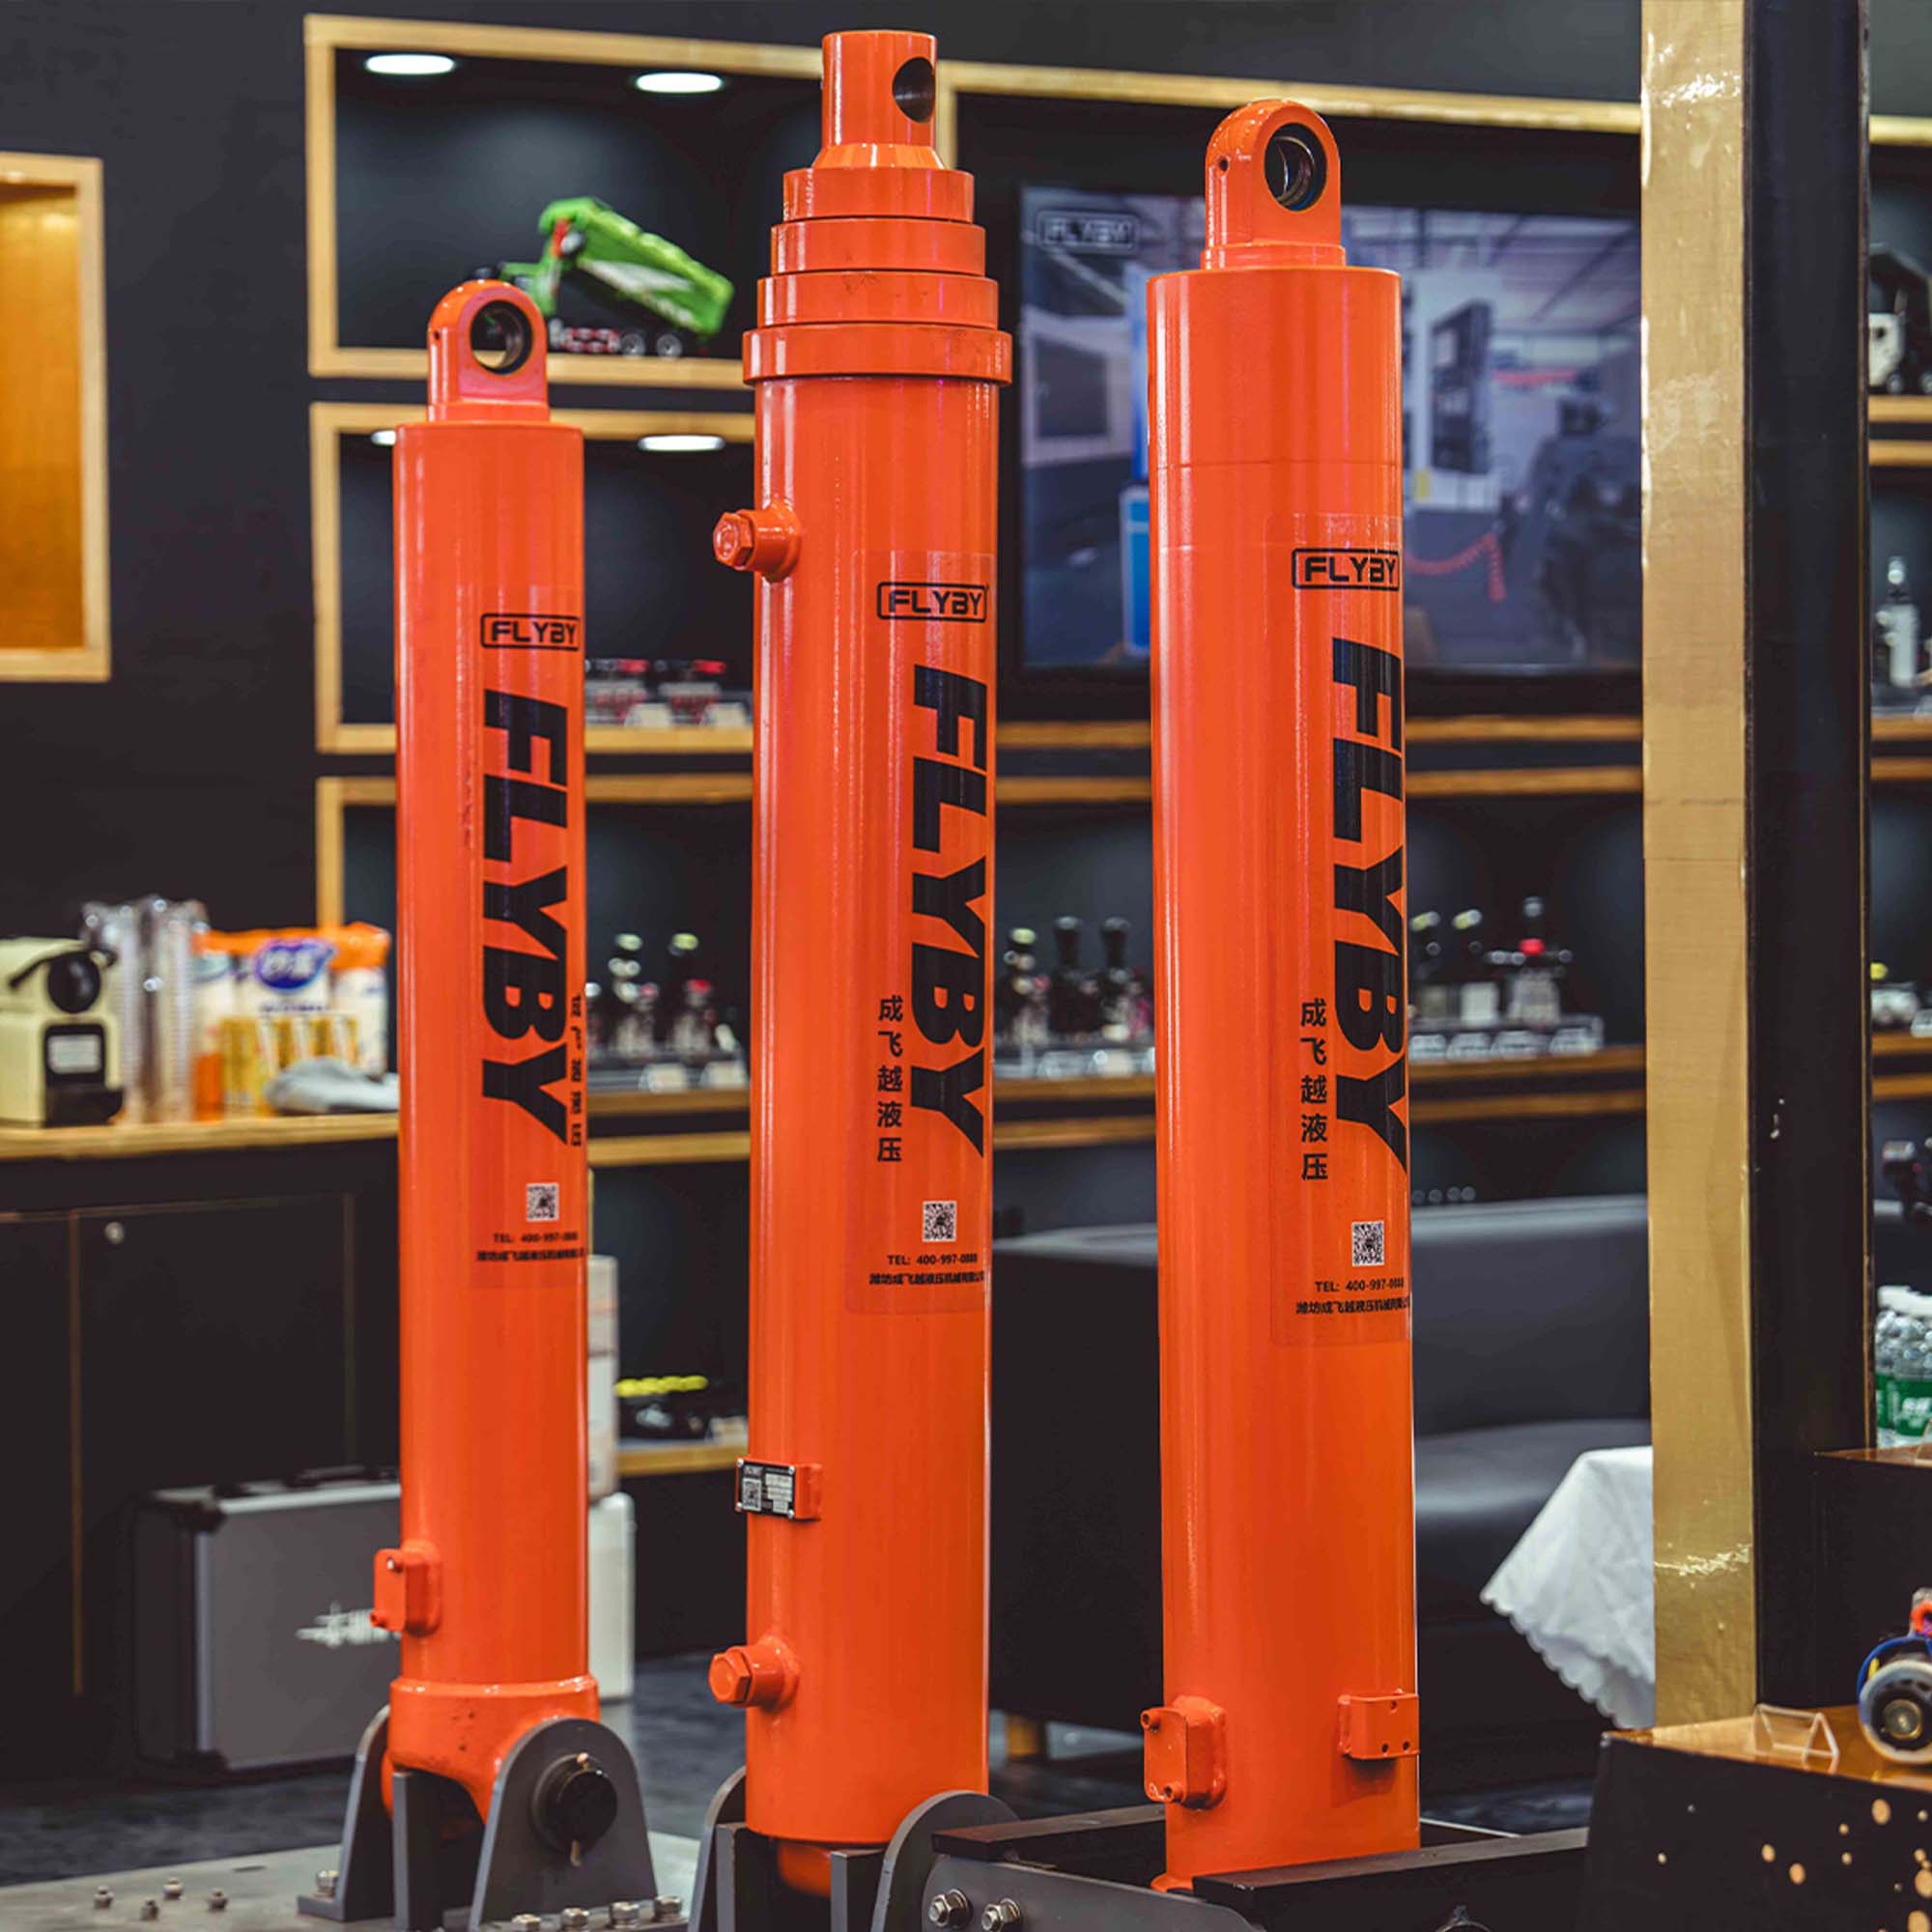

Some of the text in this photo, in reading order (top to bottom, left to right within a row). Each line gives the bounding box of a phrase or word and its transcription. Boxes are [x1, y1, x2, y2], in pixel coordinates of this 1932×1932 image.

[491, 621, 577, 644] FLYBY
[889, 589, 982, 616] FLYBY
[1305, 556, 1396, 582] FLYBY
[482, 689, 567, 1145] FLYBY
[910, 665, 987, 1157] FLYBY
[1333, 637, 1407, 1174] FLYBY
[877, 995, 903, 1162] 成飞越液压
[1300, 998, 1328, 1180] 成飞越液压
[1315, 1281, 1340, 1293] TEL:
